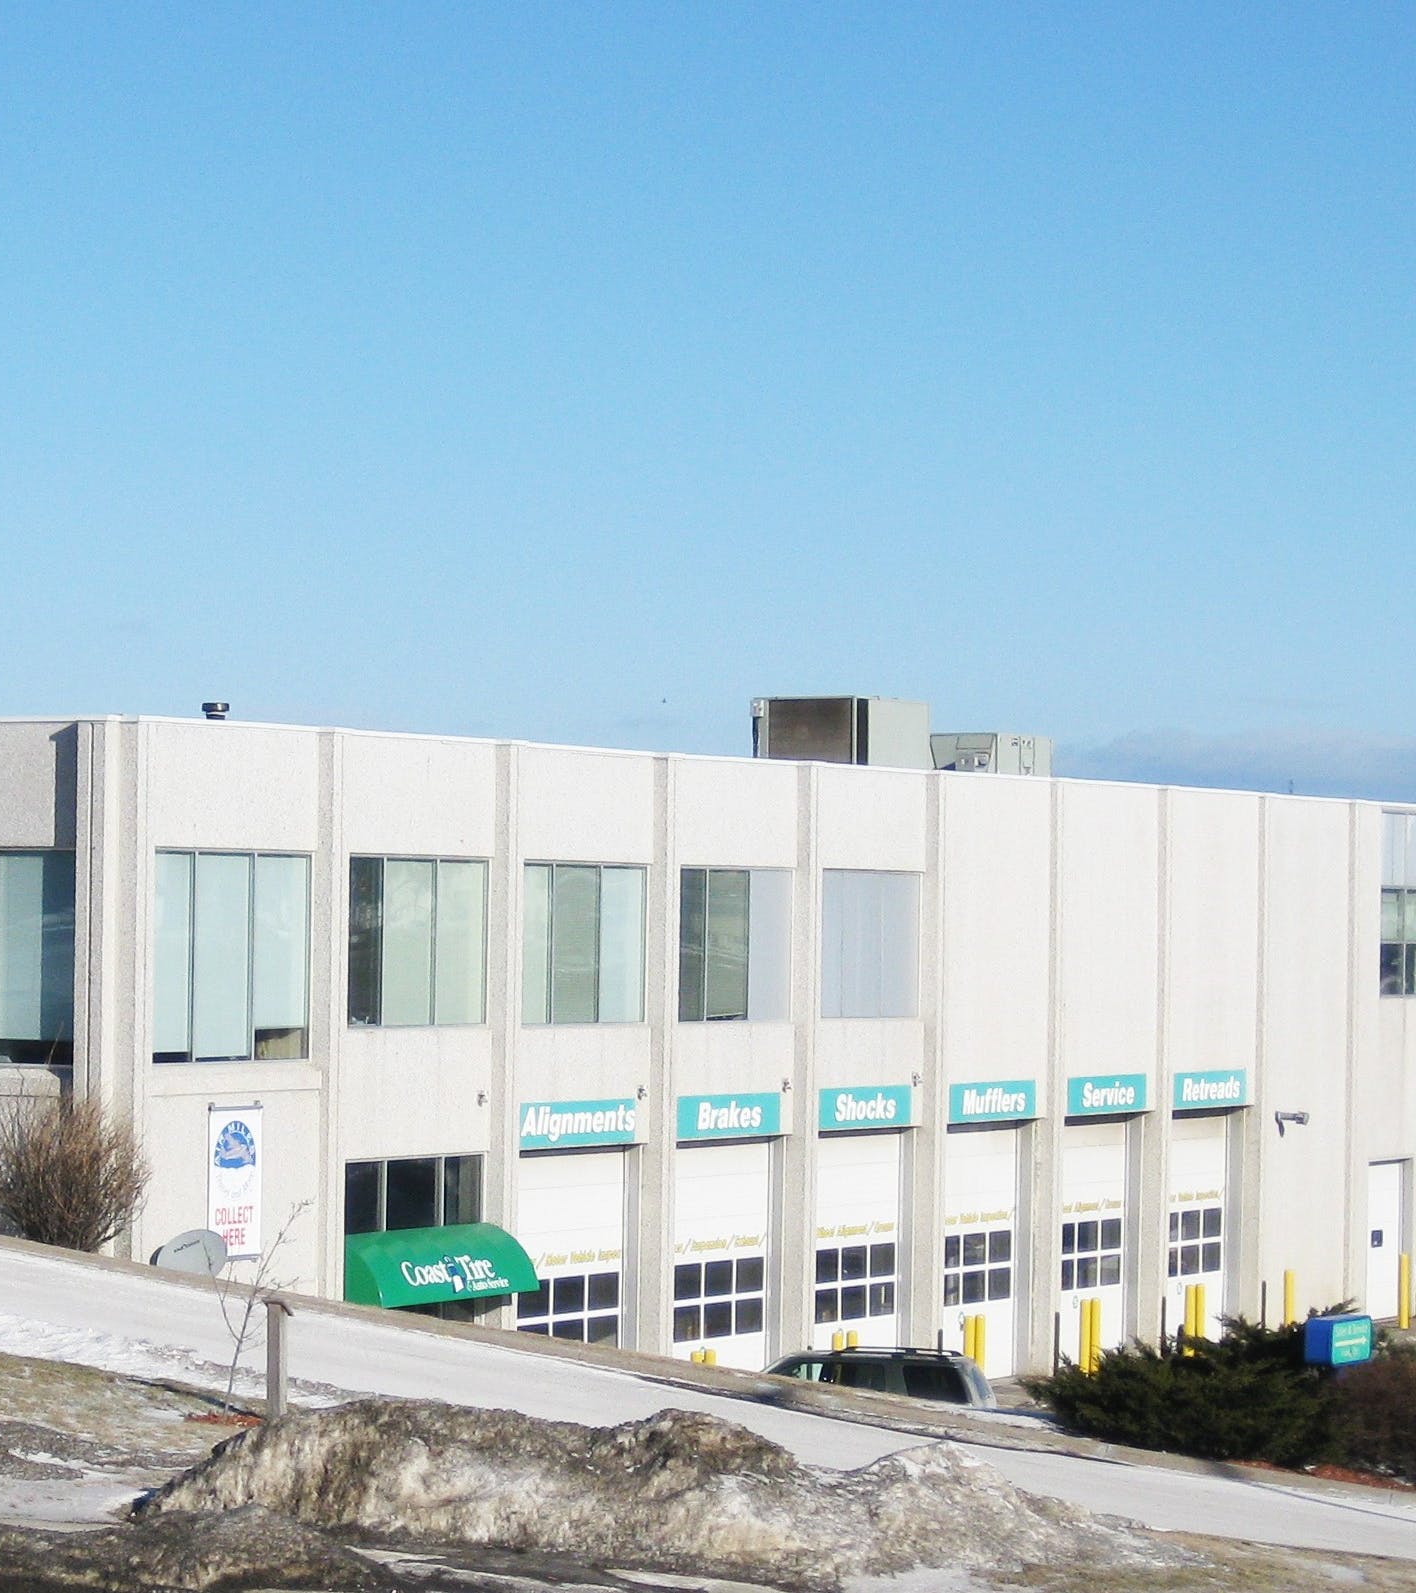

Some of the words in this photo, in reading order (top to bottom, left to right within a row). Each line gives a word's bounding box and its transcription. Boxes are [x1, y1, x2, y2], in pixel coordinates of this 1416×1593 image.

[962, 1087, 1026, 1115] Mufflers
[1082, 1081, 1134, 1107] Service
[1182, 1076, 1240, 1102] Retreads
[697, 1101, 762, 1130] Brakes
[835, 1093, 896, 1121] Shocks
[521, 1102, 635, 1142] Alignments
[215, 1205, 254, 1225] COLLECT
[221, 1228, 246, 1246] HERE
[401, 1260, 452, 1287] Coast
[454, 1254, 496, 1281] Tire
